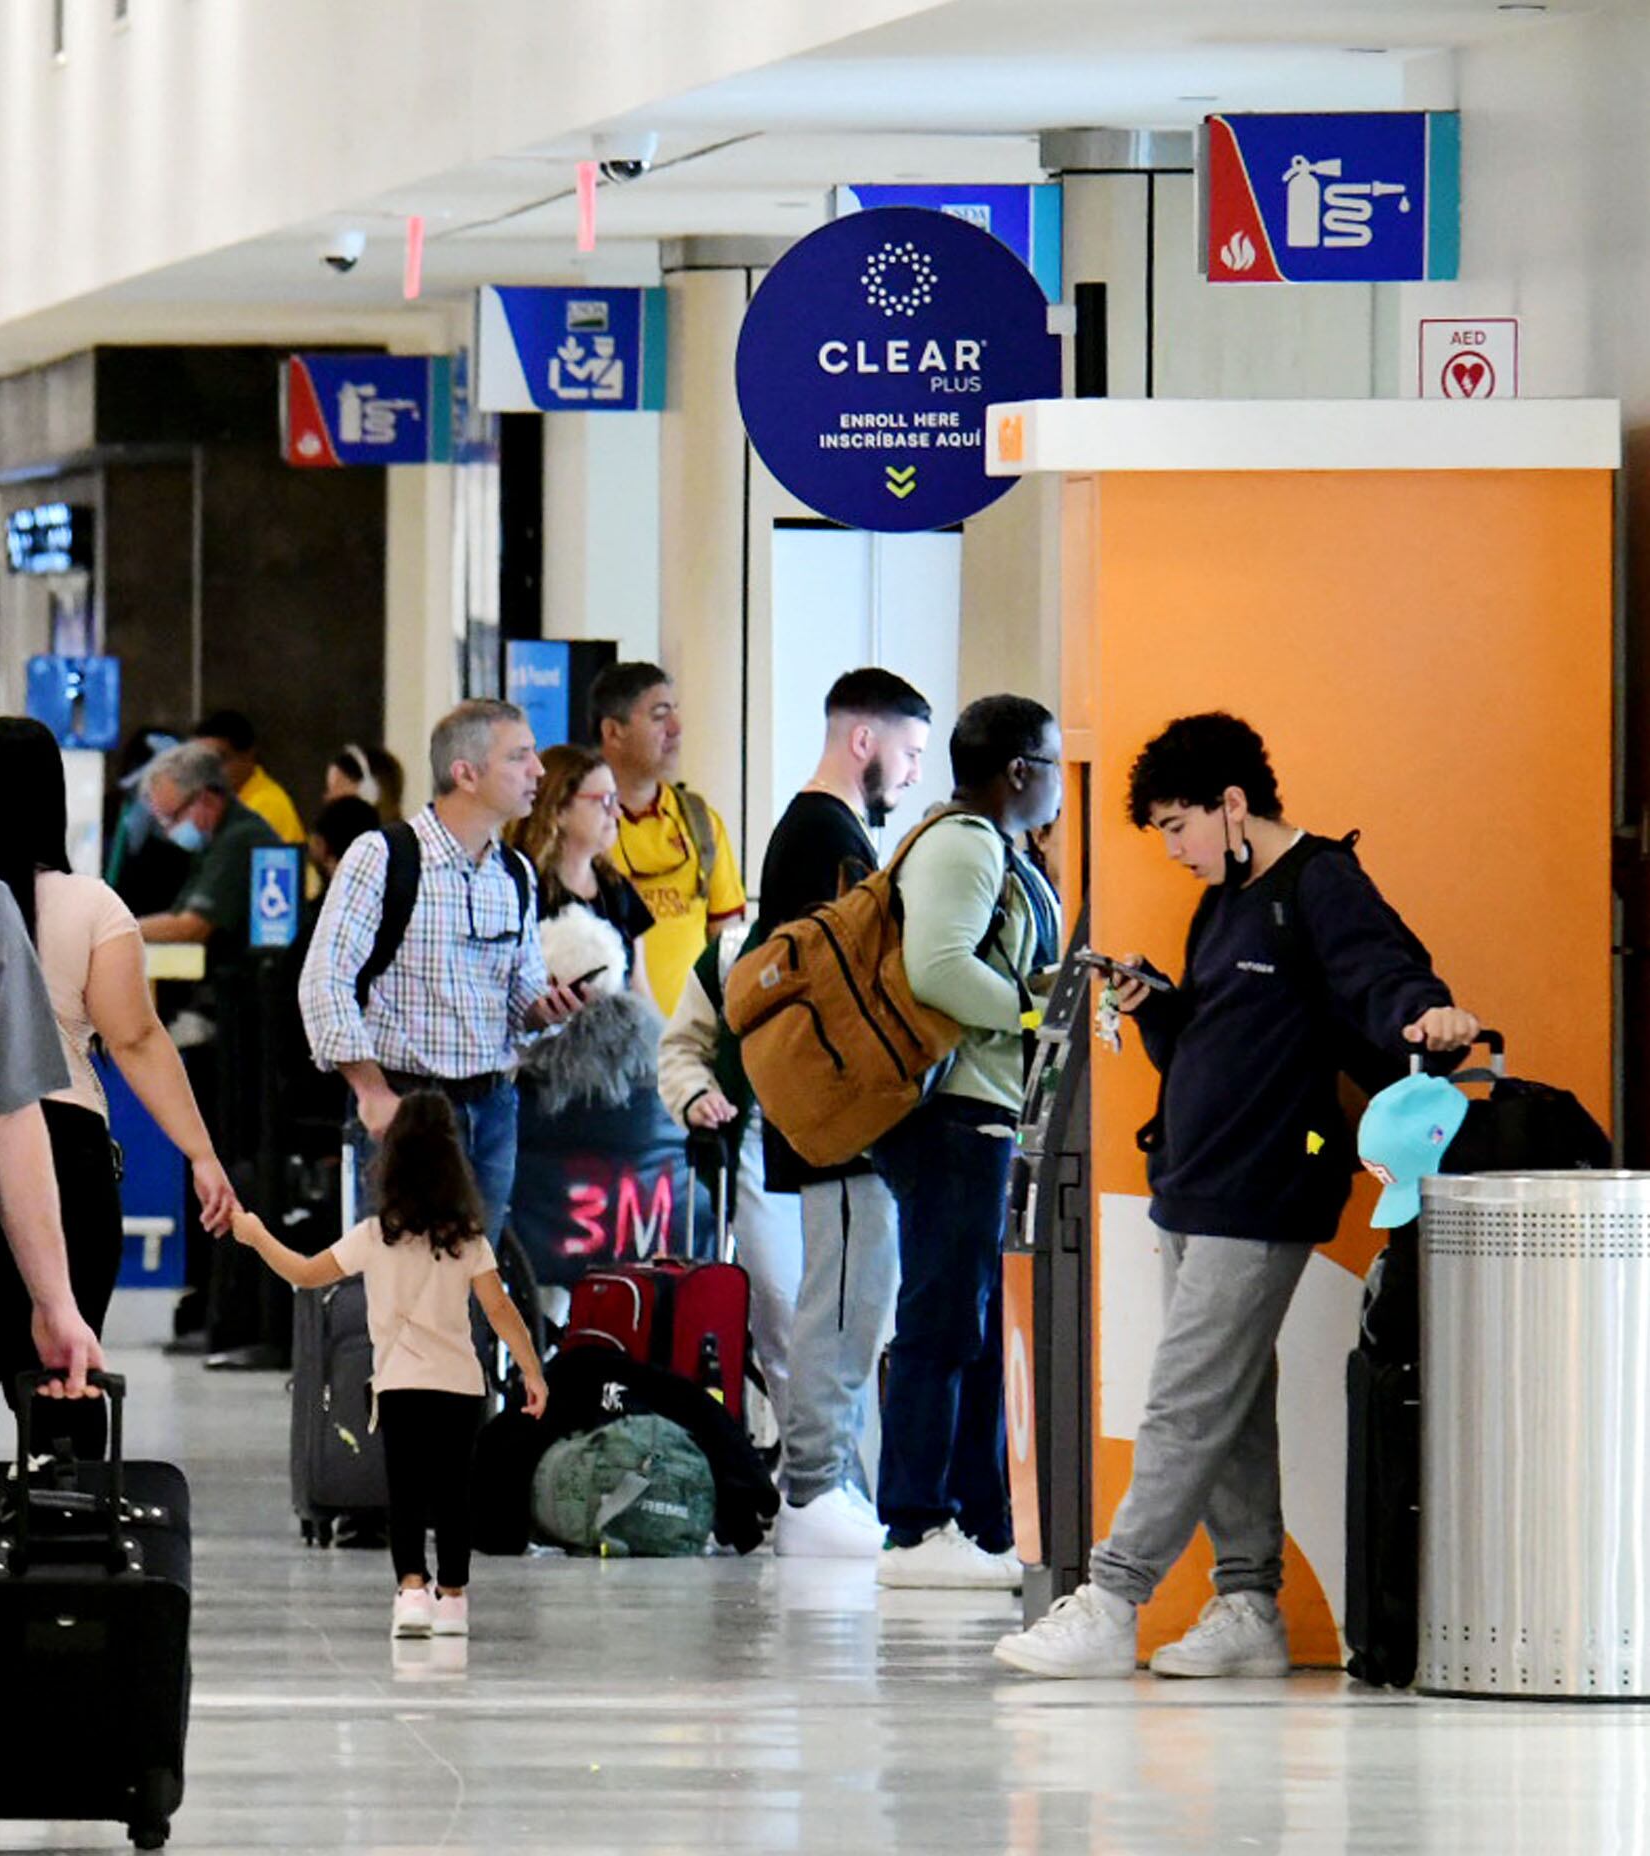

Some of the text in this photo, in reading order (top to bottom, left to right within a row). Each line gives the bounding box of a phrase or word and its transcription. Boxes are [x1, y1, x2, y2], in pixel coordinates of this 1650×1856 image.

[1451, 331, 1486, 346] AED
[818, 340, 981, 374] CLEAR
[931, 377, 982, 392] PLUS
[840, 412, 960, 429] ENROLL HERE
[819, 429, 981, 448] INSCRÍBASE AQUÍ
